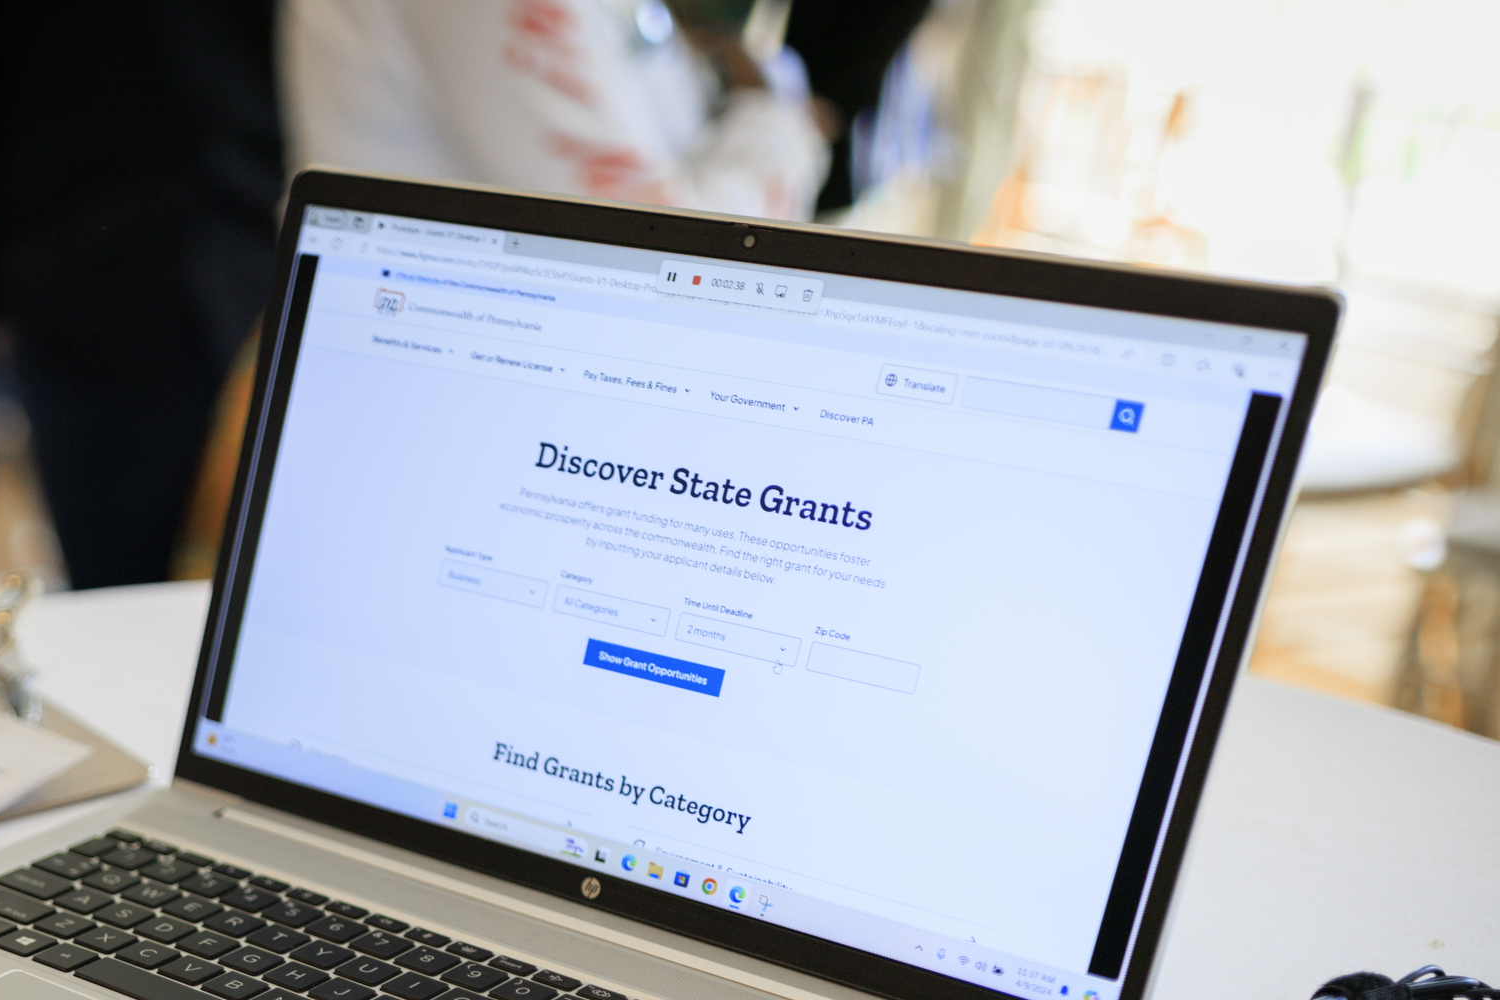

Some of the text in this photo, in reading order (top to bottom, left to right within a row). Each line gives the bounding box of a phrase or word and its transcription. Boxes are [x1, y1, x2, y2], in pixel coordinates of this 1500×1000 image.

[711, 277, 746, 291] 00:02:38
[516, 289, 556, 303] Pennsylvania
[408, 302, 543, 333] Commonwealth of Pennsylvania
[372, 333, 402, 346] Benefits
[410, 341, 442, 354] Services
[471, 351, 485, 361] Get
[495, 355, 522, 369] Renew
[523, 360, 554, 373] License
[583, 368, 598, 383] Pay
[600, 372, 624, 386] Taxes,
[626, 376, 646, 390] Fees
[654, 382, 678, 395] Fines
[903, 377, 947, 394] Translate
[710, 390, 786, 413] Your Government
[819, 408, 874, 426] Discover PA
[536, 441, 873, 531] Discover State Grants
[520, 486, 872, 568] Pennsylvania offers grant funding for many uses. These opportunities foster
[499, 501, 886, 589] economic prosperity across the commonwealth. Find the right grant for your needs
[477, 550, 494, 563] Type
[586, 535, 776, 584] by inputting your applicant details below.
[448, 569, 482, 586] Business
[560, 569, 593, 585] Category
[563, 596, 619, 617] All Categories
[684, 596, 753, 620] Time Until Deadline
[687, 624, 726, 642] 2 months
[814, 625, 851, 642] Zip Code
[598, 650, 708, 686] Show Grant Opportunities
[492, 741, 752, 835] Find Grants by Category
[483, 817, 509, 832] Search
[73, 894, 92, 905] A
[115, 909, 134, 919] S
[54, 918, 76, 929] Z
[154, 922, 174, 933] D
[224, 916, 244, 927] R
[329, 923, 345, 931] 6
[94, 932, 117, 943] X
[198, 938, 219, 947] F
[272, 931, 289, 942] T
[374, 938, 390, 946] 7
[139, 948, 158, 958] C
[242, 954, 262, 964] G
[316, 947, 333, 957] Y
[419, 954, 435, 963] 8
[184, 963, 203, 973] V
[285, 969, 307, 980] H
[359, 963, 379, 973] U
[467, 970, 482, 979] 9
[1017, 966, 1056, 984] 11:37 AM
[224, 979, 244, 990] B
[515, 987, 530, 995] 0
[333, 988, 352, 996] J
